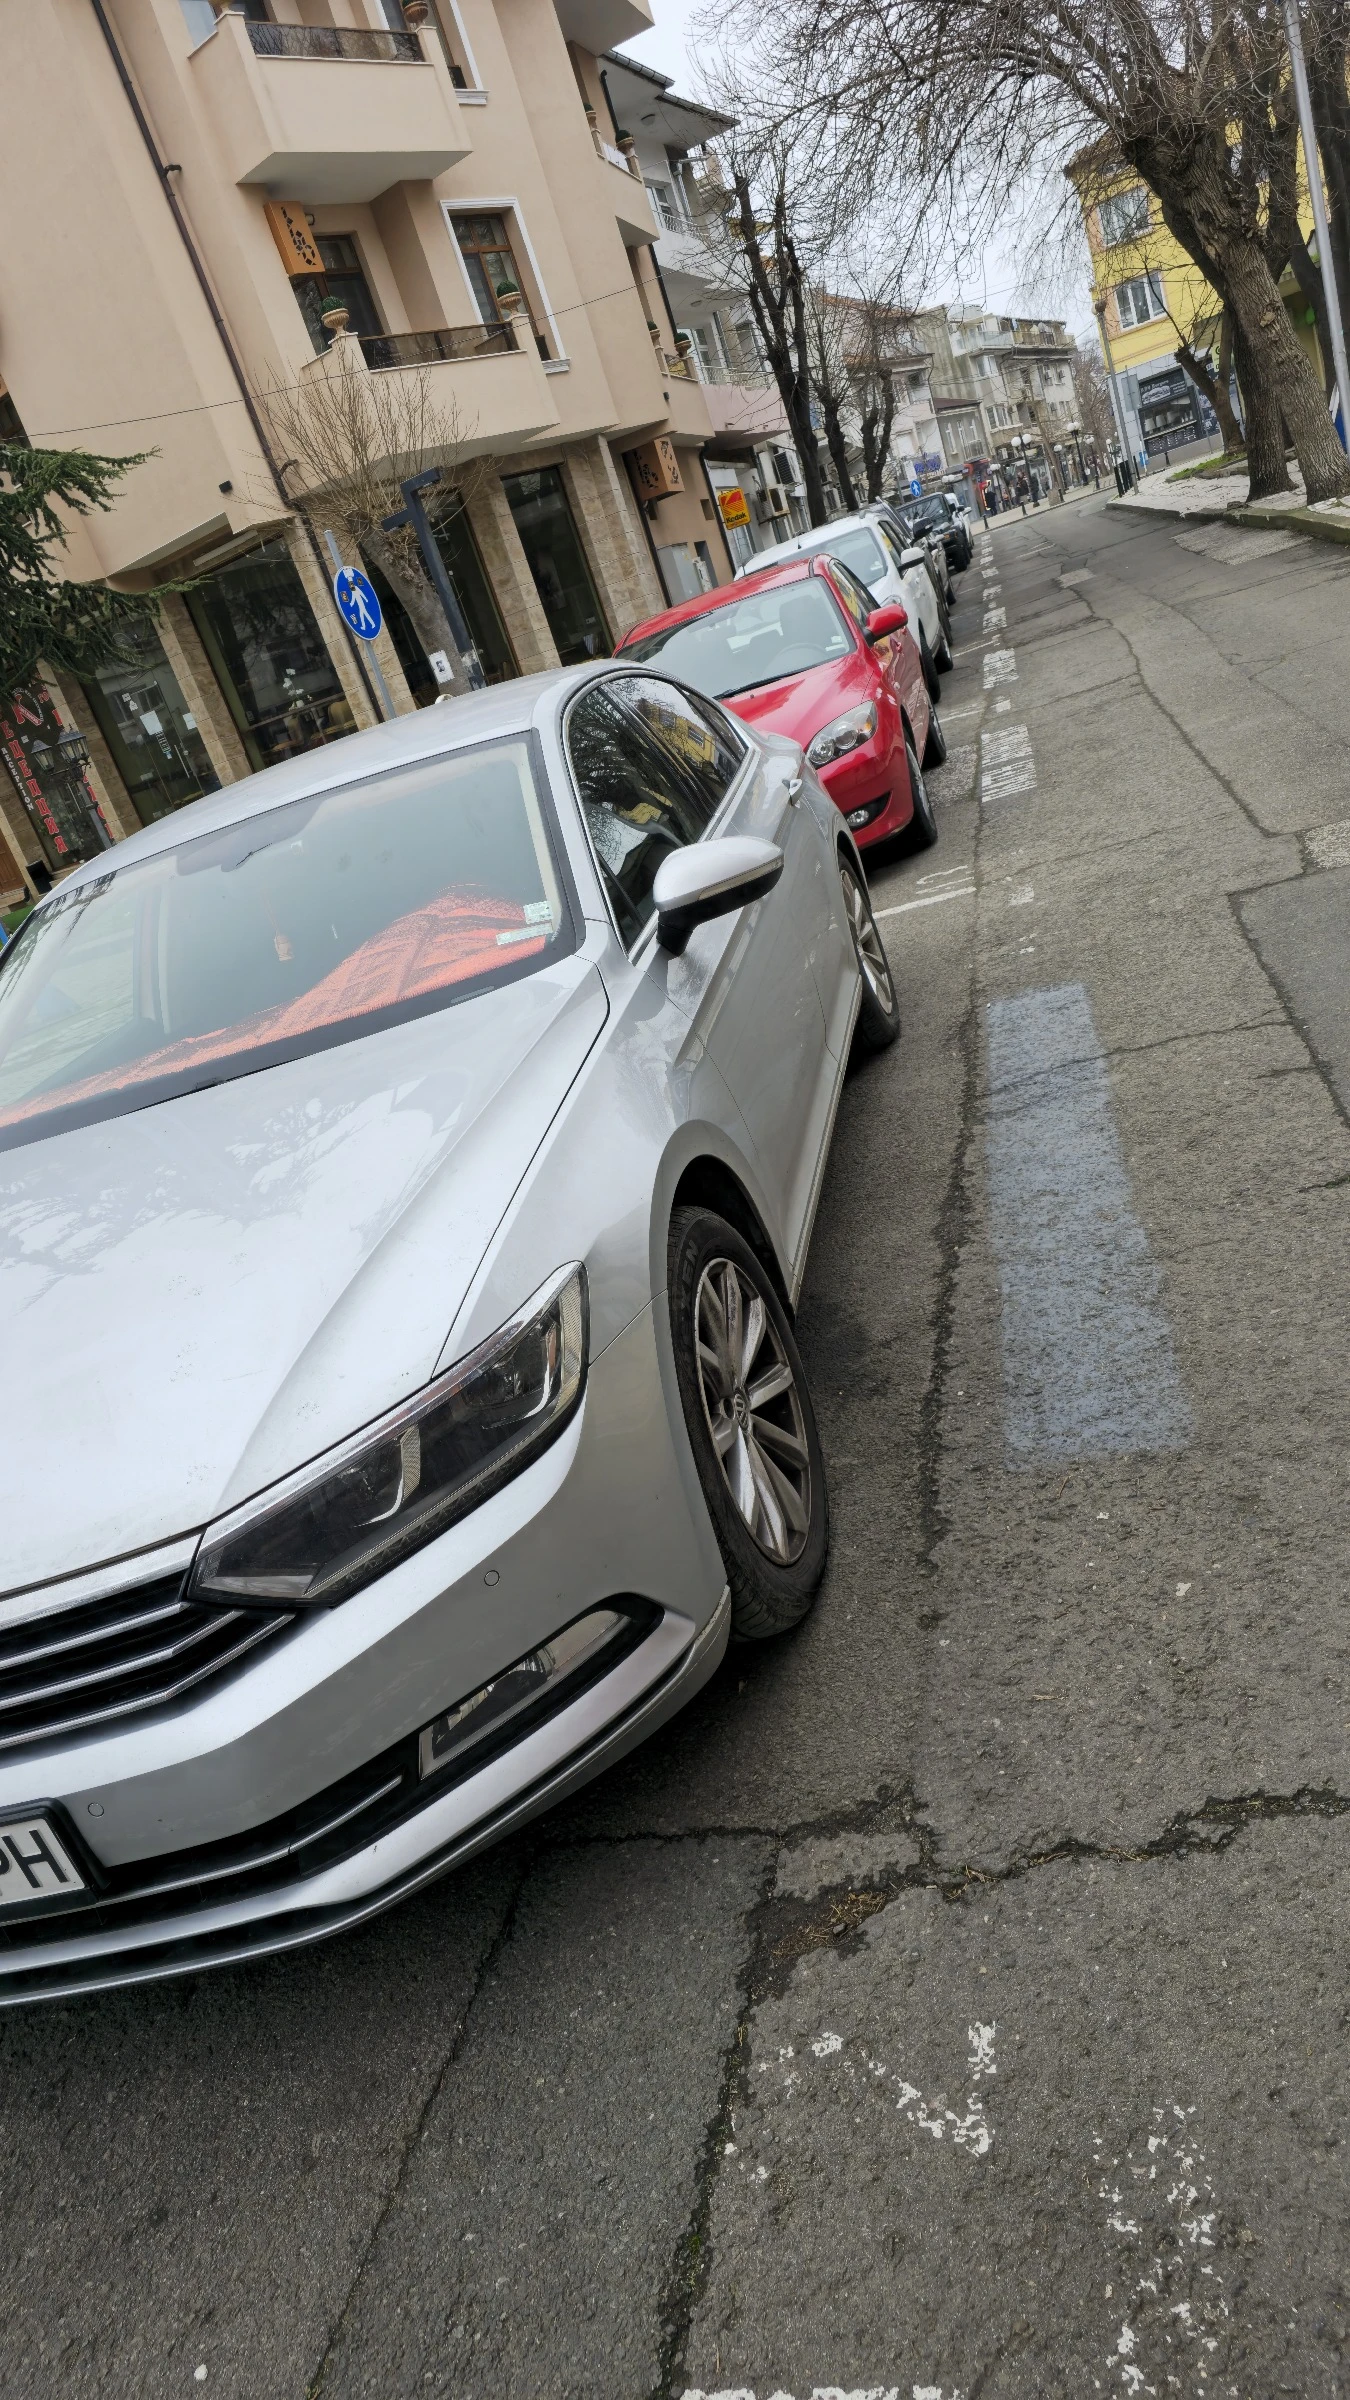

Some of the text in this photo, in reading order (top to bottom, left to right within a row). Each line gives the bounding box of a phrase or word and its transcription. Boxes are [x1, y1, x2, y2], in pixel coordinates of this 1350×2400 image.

[726, 512, 746, 523] Kodak
[0, 706, 68, 854] ЕЦЕПЦИЯ
[1, 747, 34, 811] RECEPTION
